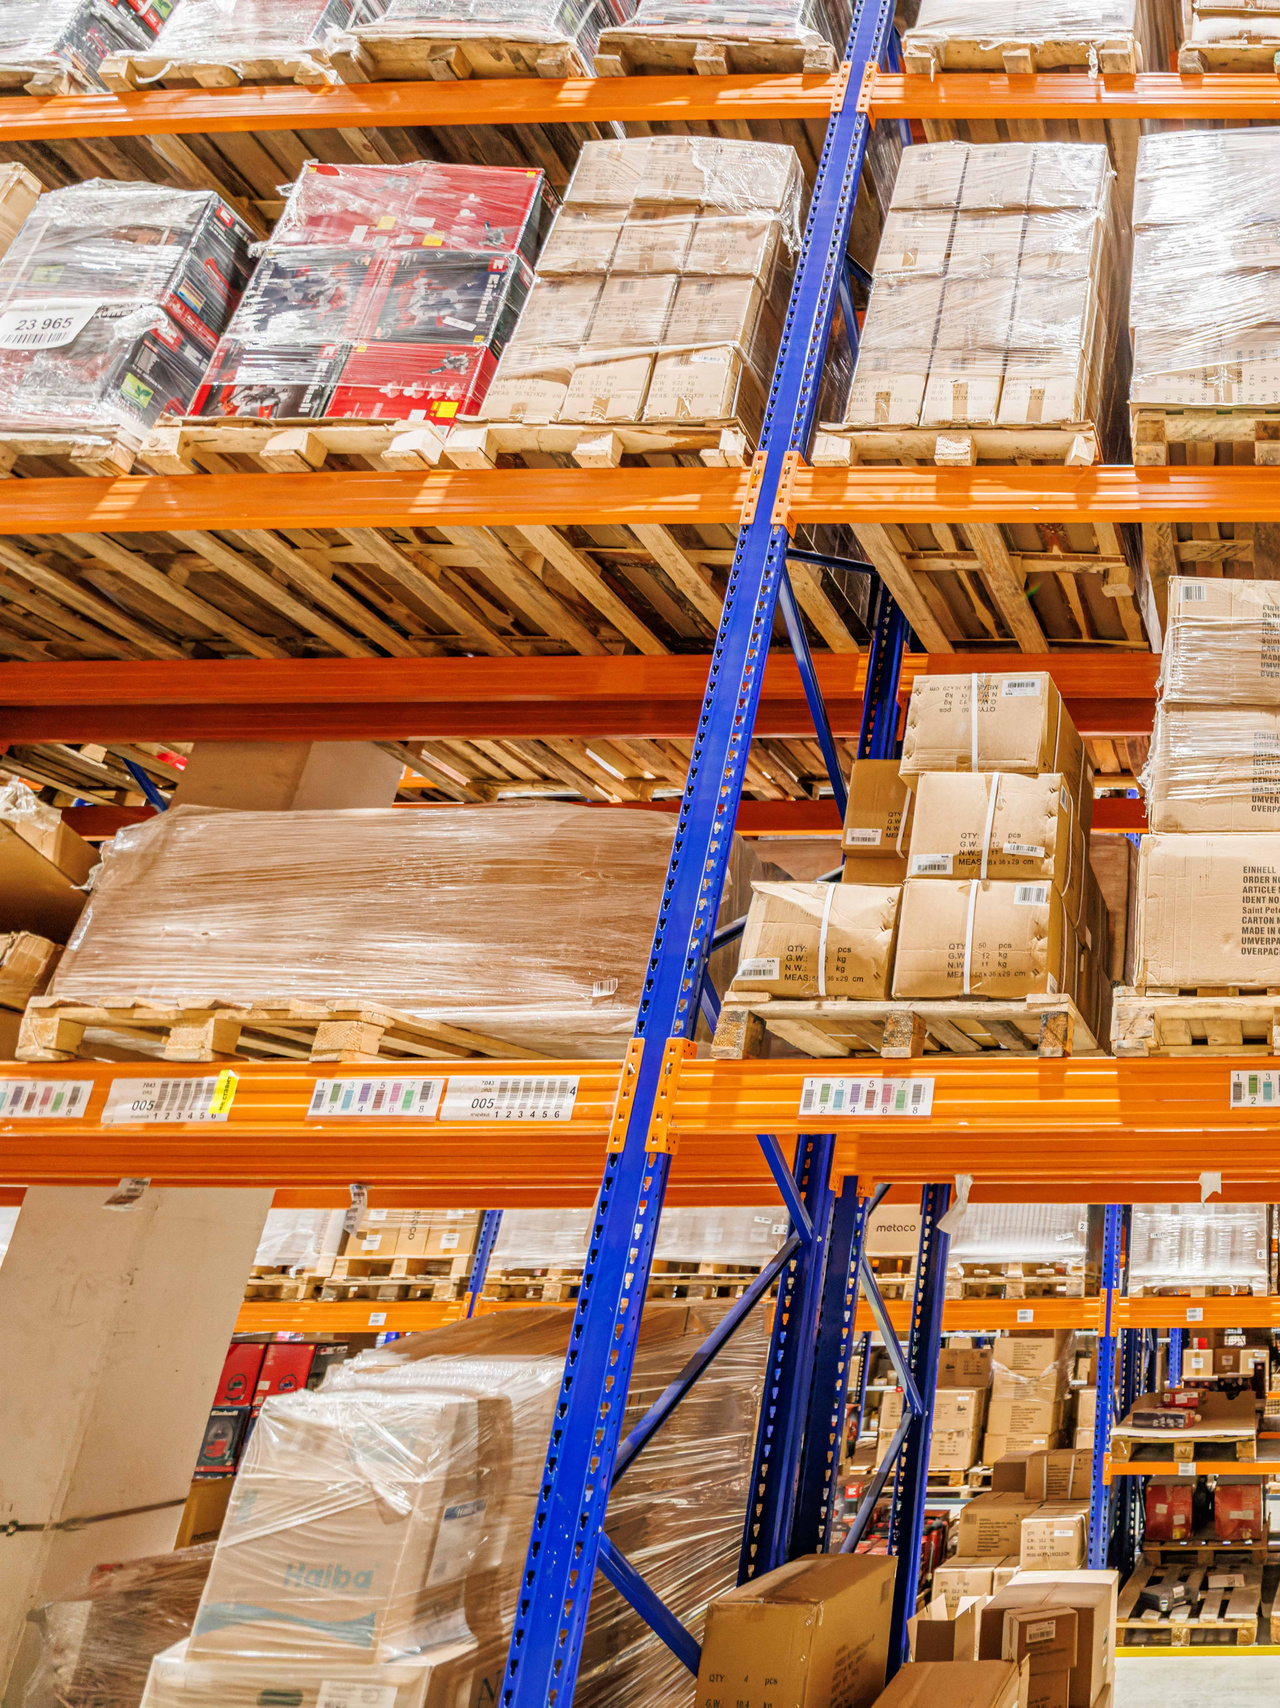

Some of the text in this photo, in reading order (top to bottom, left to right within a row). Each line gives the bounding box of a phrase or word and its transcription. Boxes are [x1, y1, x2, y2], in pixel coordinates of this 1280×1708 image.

[15, 318, 73, 331] 23 965
[1243, 866, 1276, 874] EINHELL
[1243, 886, 1276, 894] ARTICLE
[836, 965, 845, 973] kg
[1266, 1073, 1271, 1081] 3
[838, 1080, 844, 1088] 3
[869, 1080, 875, 1088] 5
[570, 1087, 576, 1095] 4
[132, 1100, 155, 1110] 005
[471, 1098, 495, 1109] 005
[1251, 1097, 1256, 1105] 2
[820, 1106, 826, 1114] 2
[882, 1106, 887, 1114] 6
[876, 1223, 917, 1233] metaco
[283, 1561, 375, 1590] Haiba
[765, 1677, 778, 1686] pcs
